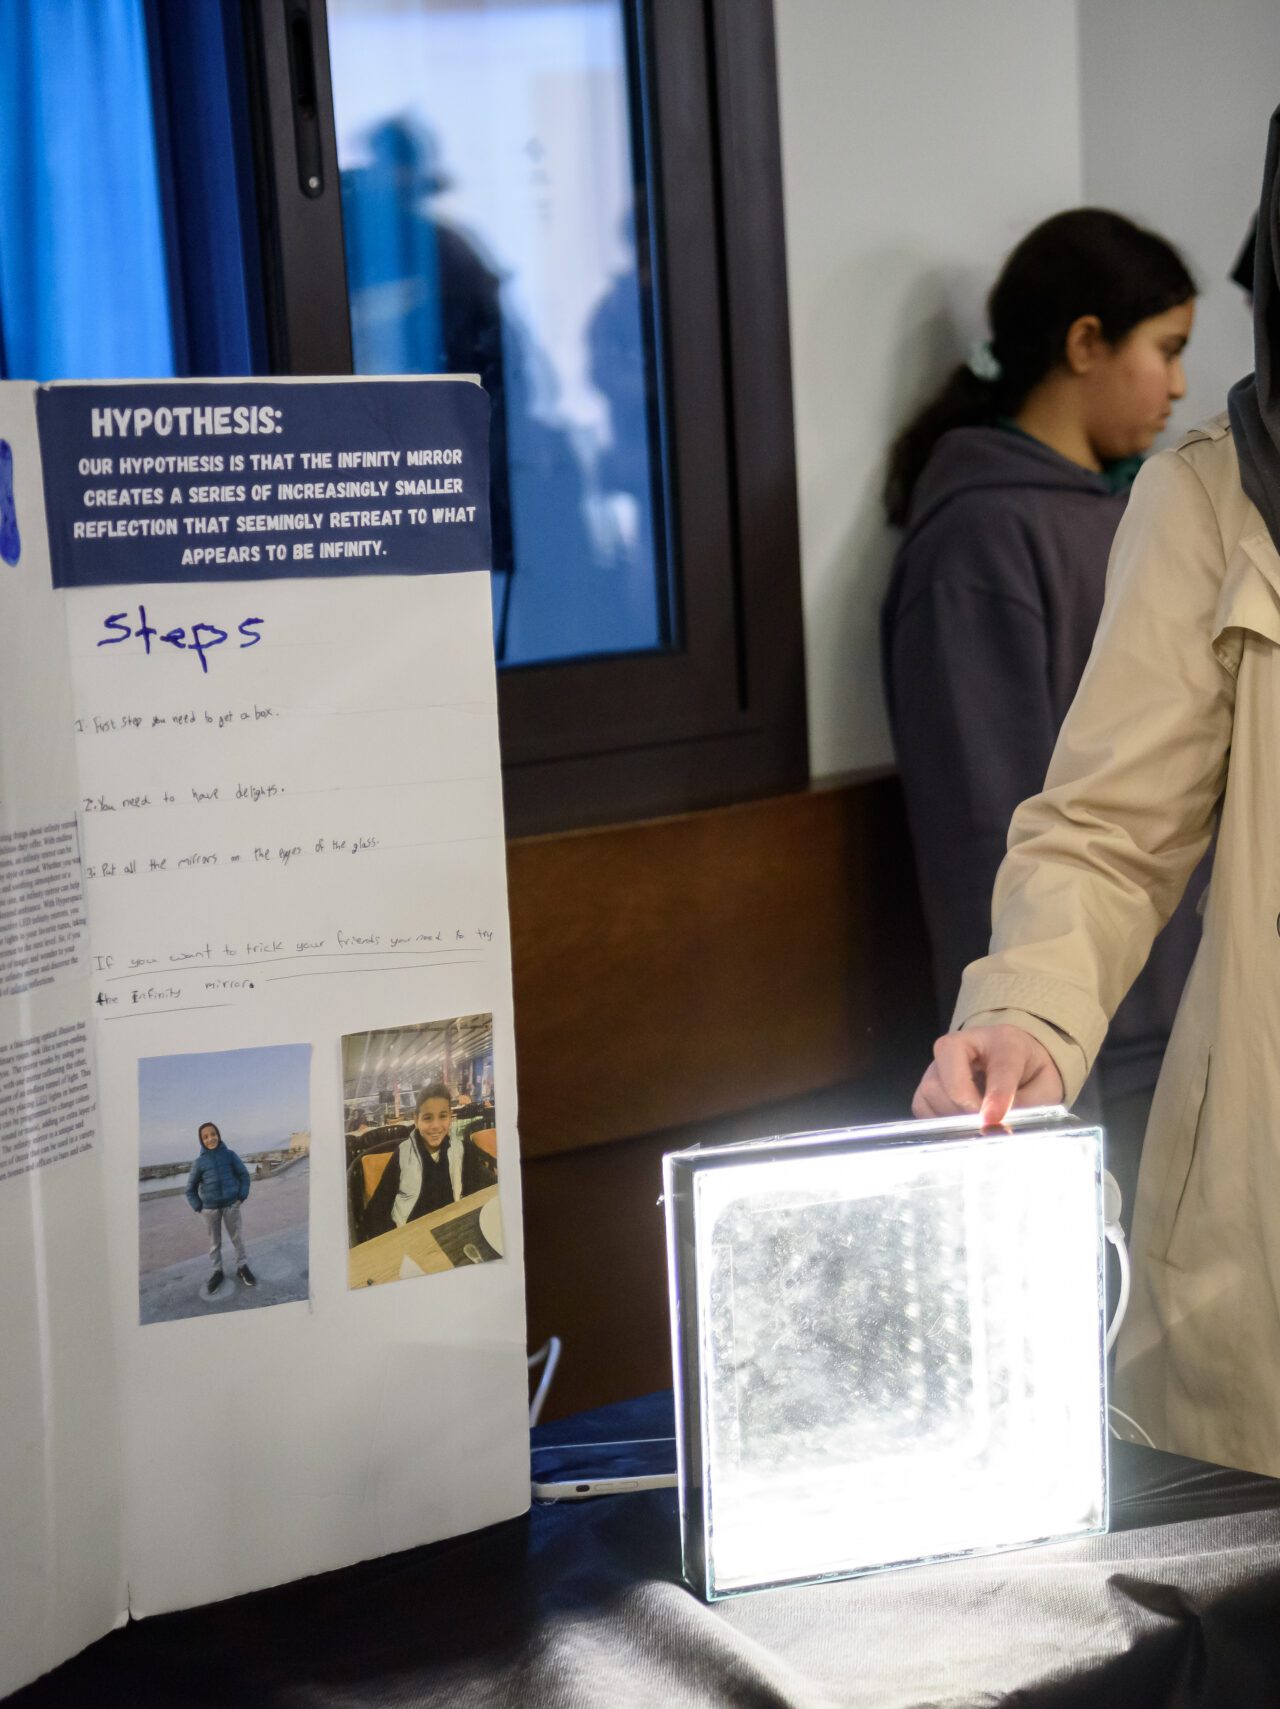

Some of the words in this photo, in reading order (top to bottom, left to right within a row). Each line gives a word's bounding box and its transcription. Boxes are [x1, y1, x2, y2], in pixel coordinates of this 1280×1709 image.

[91, 406, 283, 438] HYPOTHESIS:
[78, 458, 113, 475] OUR
[119, 455, 224, 475] HYPOTHESIS
[229, 455, 245, 471] IS
[250, 453, 294, 470] THAT
[300, 453, 332, 469] THE
[338, 451, 400, 468] INFINITY
[407, 449, 462, 466] MIRROR
[83, 488, 163, 507] CREATES
[170, 487, 183, 504] A
[188, 486, 246, 503] SERIES
[251, 484, 271, 501] OF
[278, 481, 389, 500] INCREASINGLY
[395, 478, 463, 496] SMALLER
[73, 518, 178, 538] REFLECTION
[183, 516, 230, 534] THAT
[236, 513, 323, 532] SEEMINGLY
[329, 510, 402, 528] RETREAT
[408, 509, 427, 524] TO
[432, 507, 476, 523] WHAT
[181, 546, 260, 565] APPEARS
[265, 545, 287, 560] TO
[292, 543, 314, 560] BE
[319, 540, 388, 558] INFINITY.
[172, 711, 195, 725] need
[205, 711, 213, 723] to
[218, 711, 233, 728] get
[254, 704, 279, 720] box.
[122, 795, 151, 808] need
[163, 792, 175, 803] to
[191, 788, 219, 801] have
[102, 862, 116, 877] Put
[124, 859, 136, 874] all
[149, 858, 168, 871] the
[177, 854, 218, 869] mirrors
[254, 848, 270, 861] the
[315, 838, 324, 853] of
[332, 839, 346, 850] the
[93, 955, 113, 971] If
[128, 957, 158, 969] you
[169, 943, 211, 962] want
[222, 943, 237, 956] to
[246, 941, 284, 955] trick
[296, 940, 325, 952] your
[336, 929, 380, 949] friends
[390, 936, 411, 948] you
[415, 931, 442, 941] need
[475, 927, 494, 942] try
[96, 991, 119, 1007] the
[131, 986, 181, 1004] Infinity
[205, 979, 254, 991] mirror.
